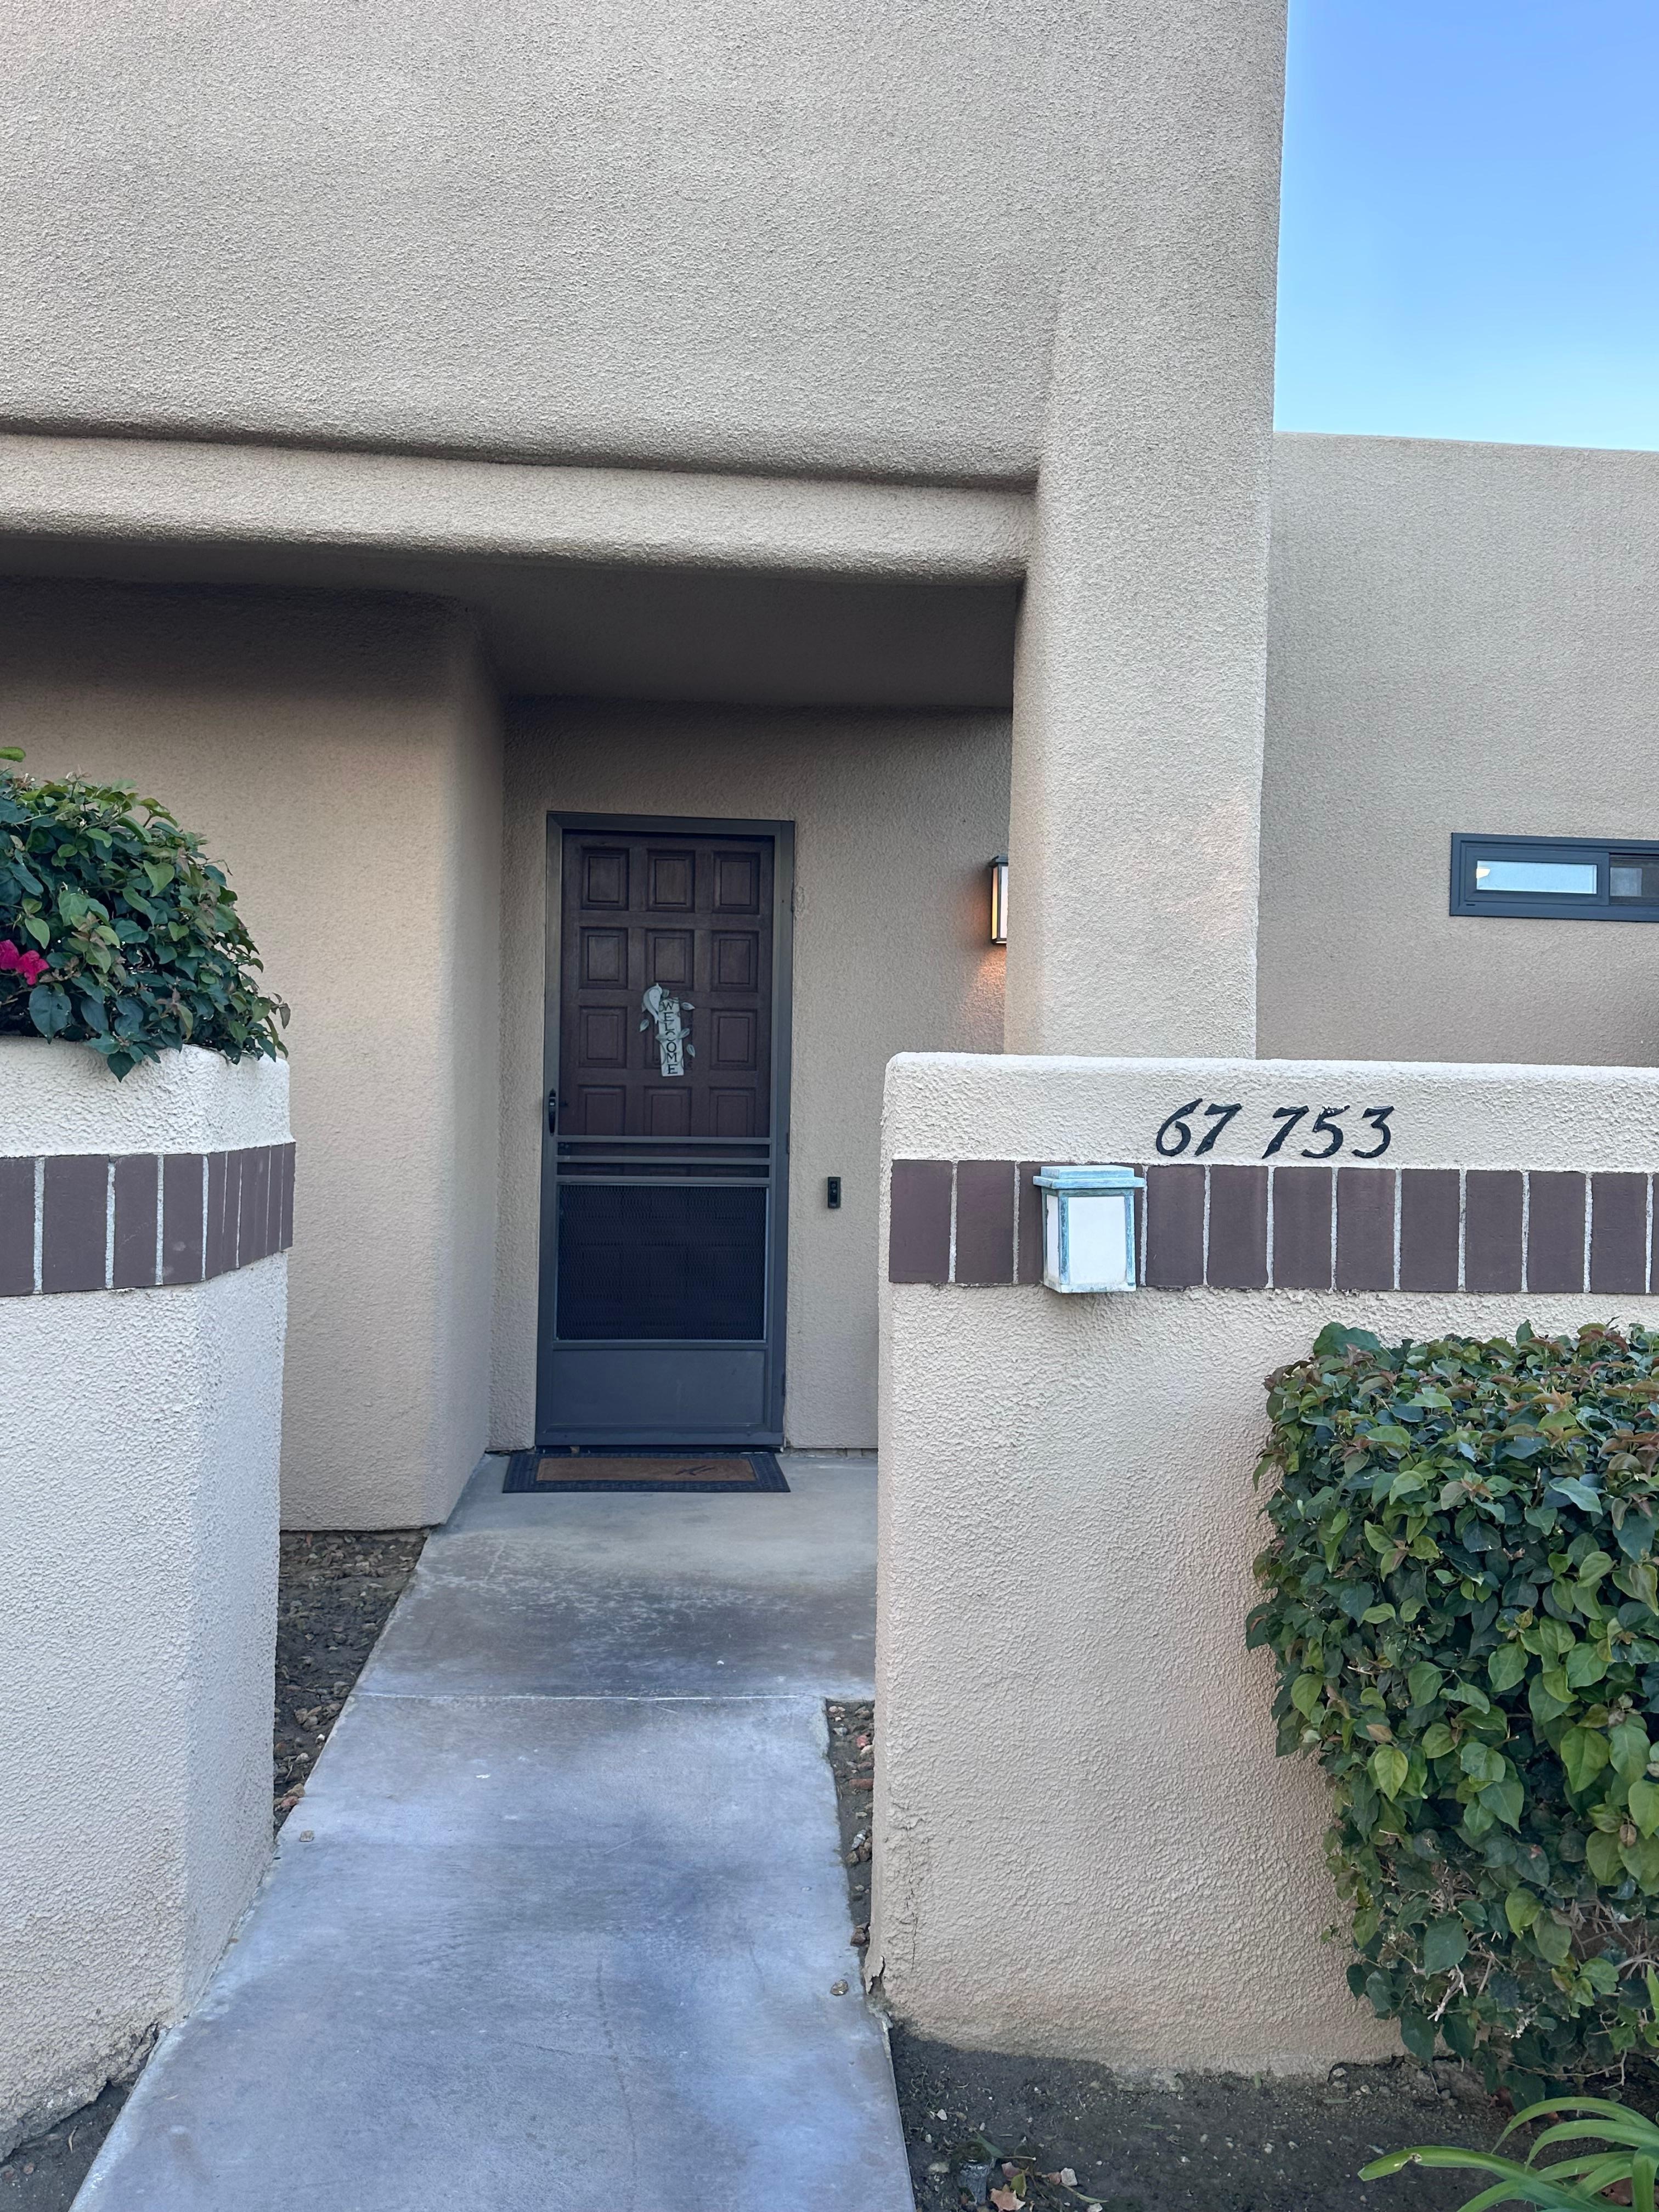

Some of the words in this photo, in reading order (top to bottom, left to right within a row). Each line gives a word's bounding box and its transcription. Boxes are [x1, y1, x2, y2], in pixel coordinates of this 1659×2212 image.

[662, 1001, 678, 1075] WELCOME
[1156, 1098, 1243, 1156] 67
[1262, 1105, 1395, 1159] 753
